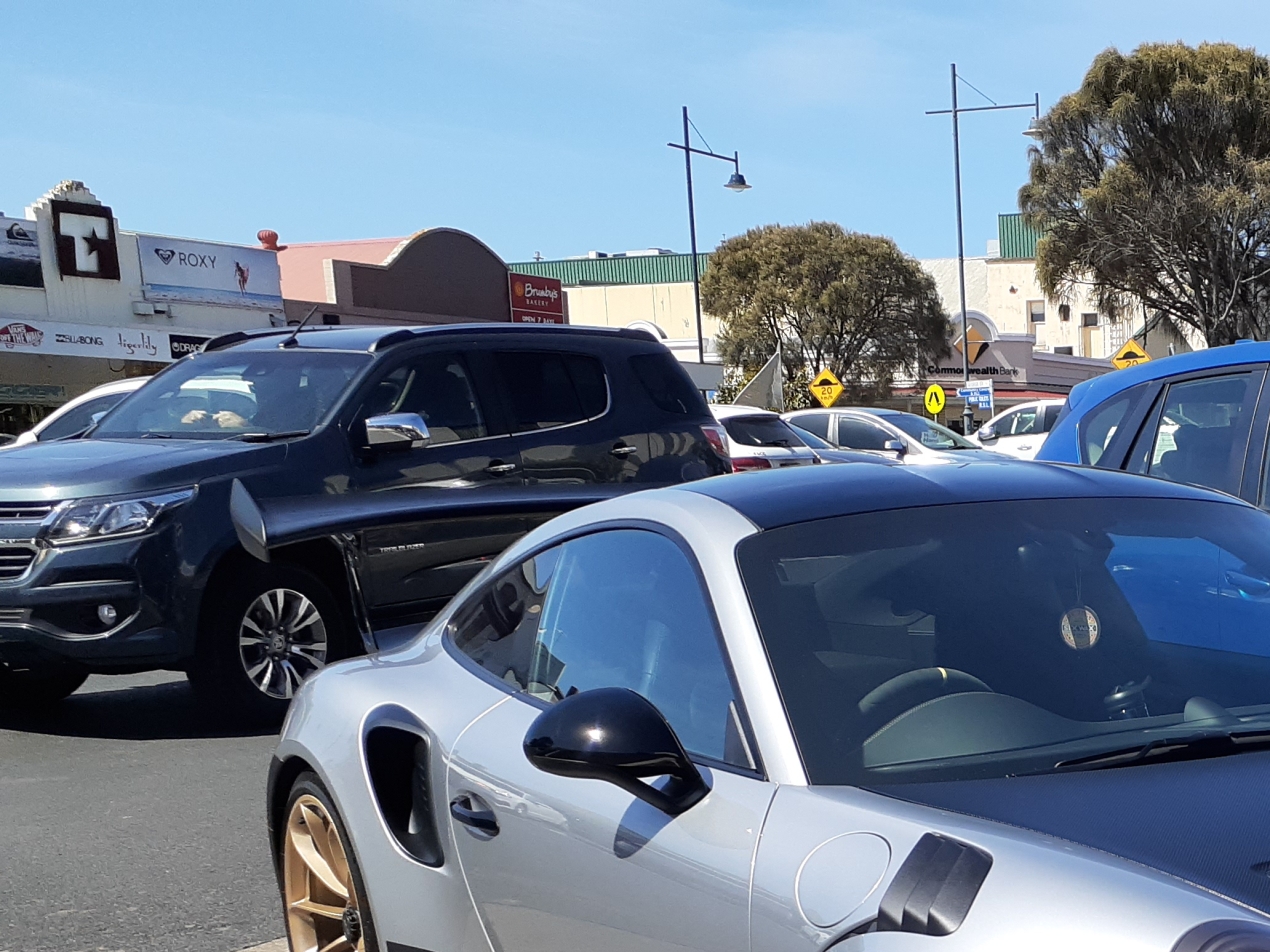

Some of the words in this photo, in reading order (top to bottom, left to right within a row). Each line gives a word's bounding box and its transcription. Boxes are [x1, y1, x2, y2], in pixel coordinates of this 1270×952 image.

[178, 252, 216, 268] ROXY
[525, 283, 558, 302] Brumby's
[8, 324, 26, 334] VANS
[64, 334, 104, 346] BILLABONG
[117, 332, 157, 356] tigerlily
[927, 366, 999, 375] Commowealth
[1000, 366, 1019, 376] Bank
[821, 387, 833, 395] 20
[379, 543, 425, 554] TRAILBLAZER
